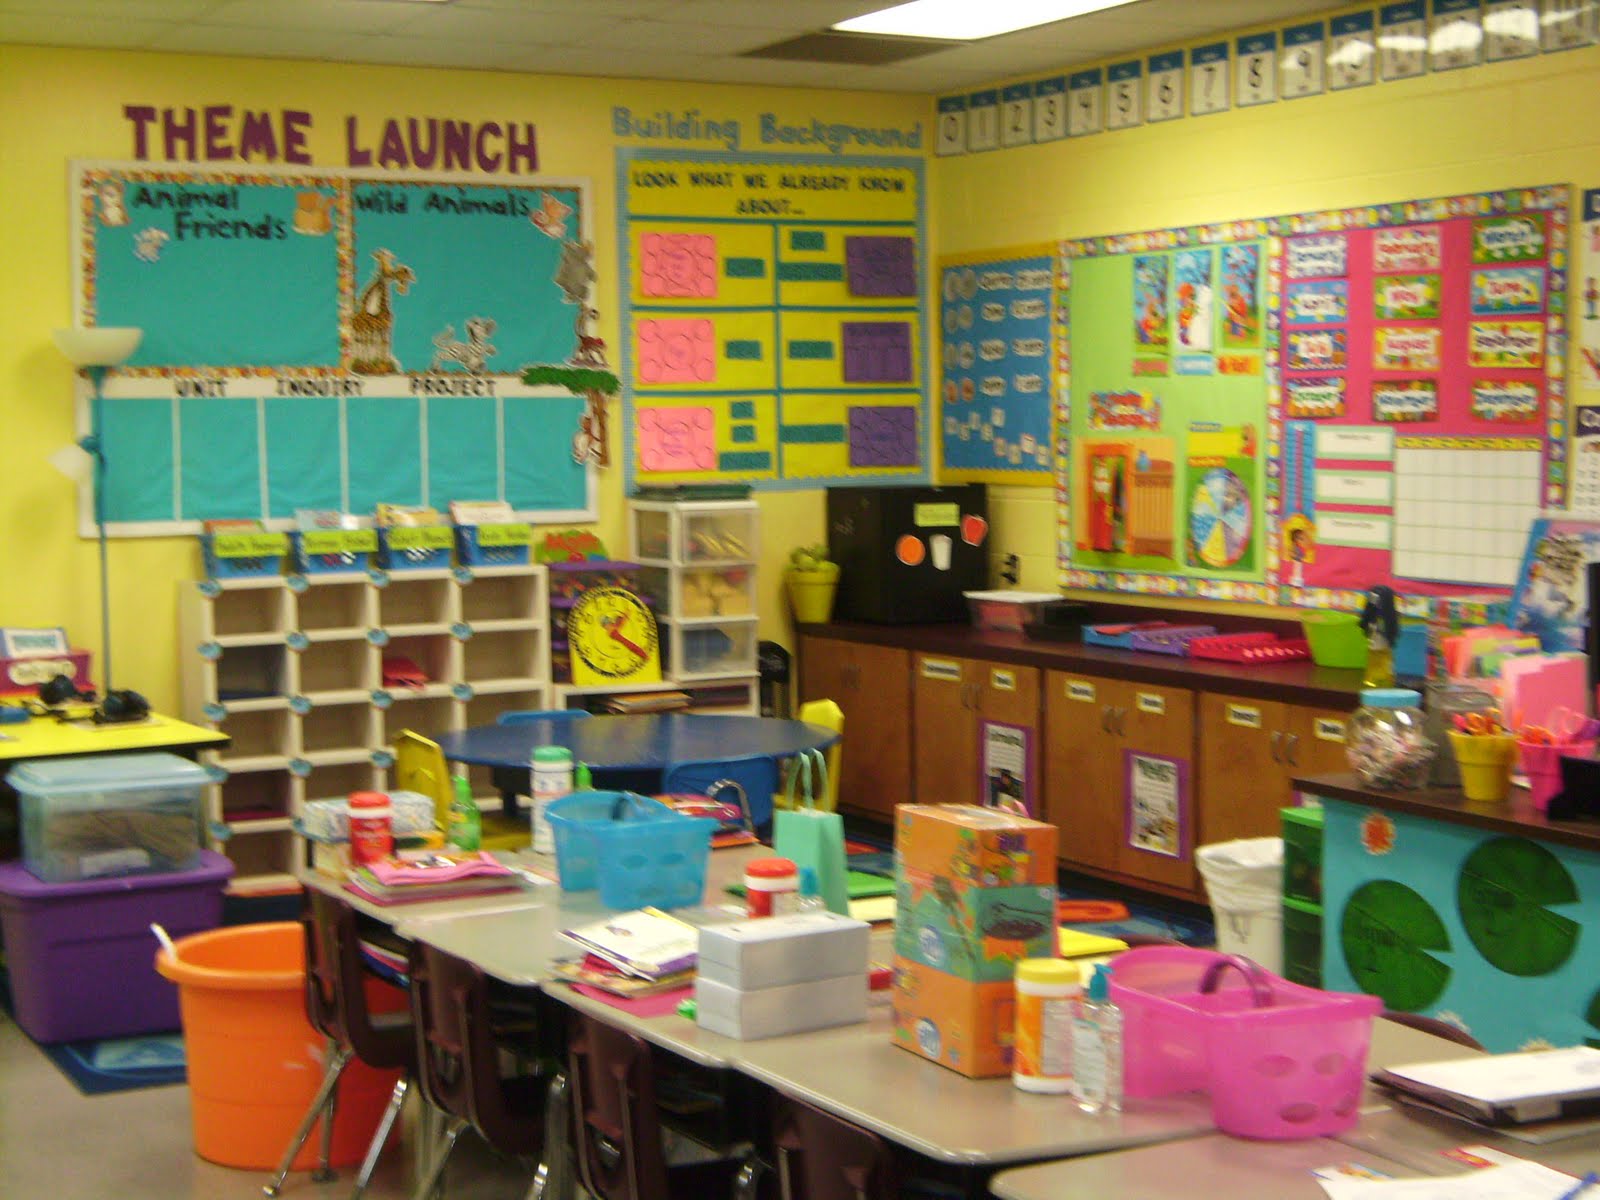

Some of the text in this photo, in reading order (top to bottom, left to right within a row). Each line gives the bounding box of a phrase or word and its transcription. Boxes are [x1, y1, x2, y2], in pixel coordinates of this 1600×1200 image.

[1203, 64, 1216, 99] 7
[1248, 56, 1263, 88] 8
[1117, 82, 1132, 113] 5
[1158, 73, 1174, 105] 6
[943, 113, 959, 142] 0
[1010, 103, 1024, 133] 2
[1043, 98, 1058, 127] 3
[123, 104, 540, 174] THEME LAUNCH
[612, 105, 922, 154] Building Background
[132, 183, 240, 210] Animal
[632, 170, 906, 193] LOOK WHAT WE ALREADY KNOW
[424, 186, 532, 217] Animals
[173, 210, 289, 241] Friends
[173, 376, 496, 398] UNIT INQUIRY PROJECT
